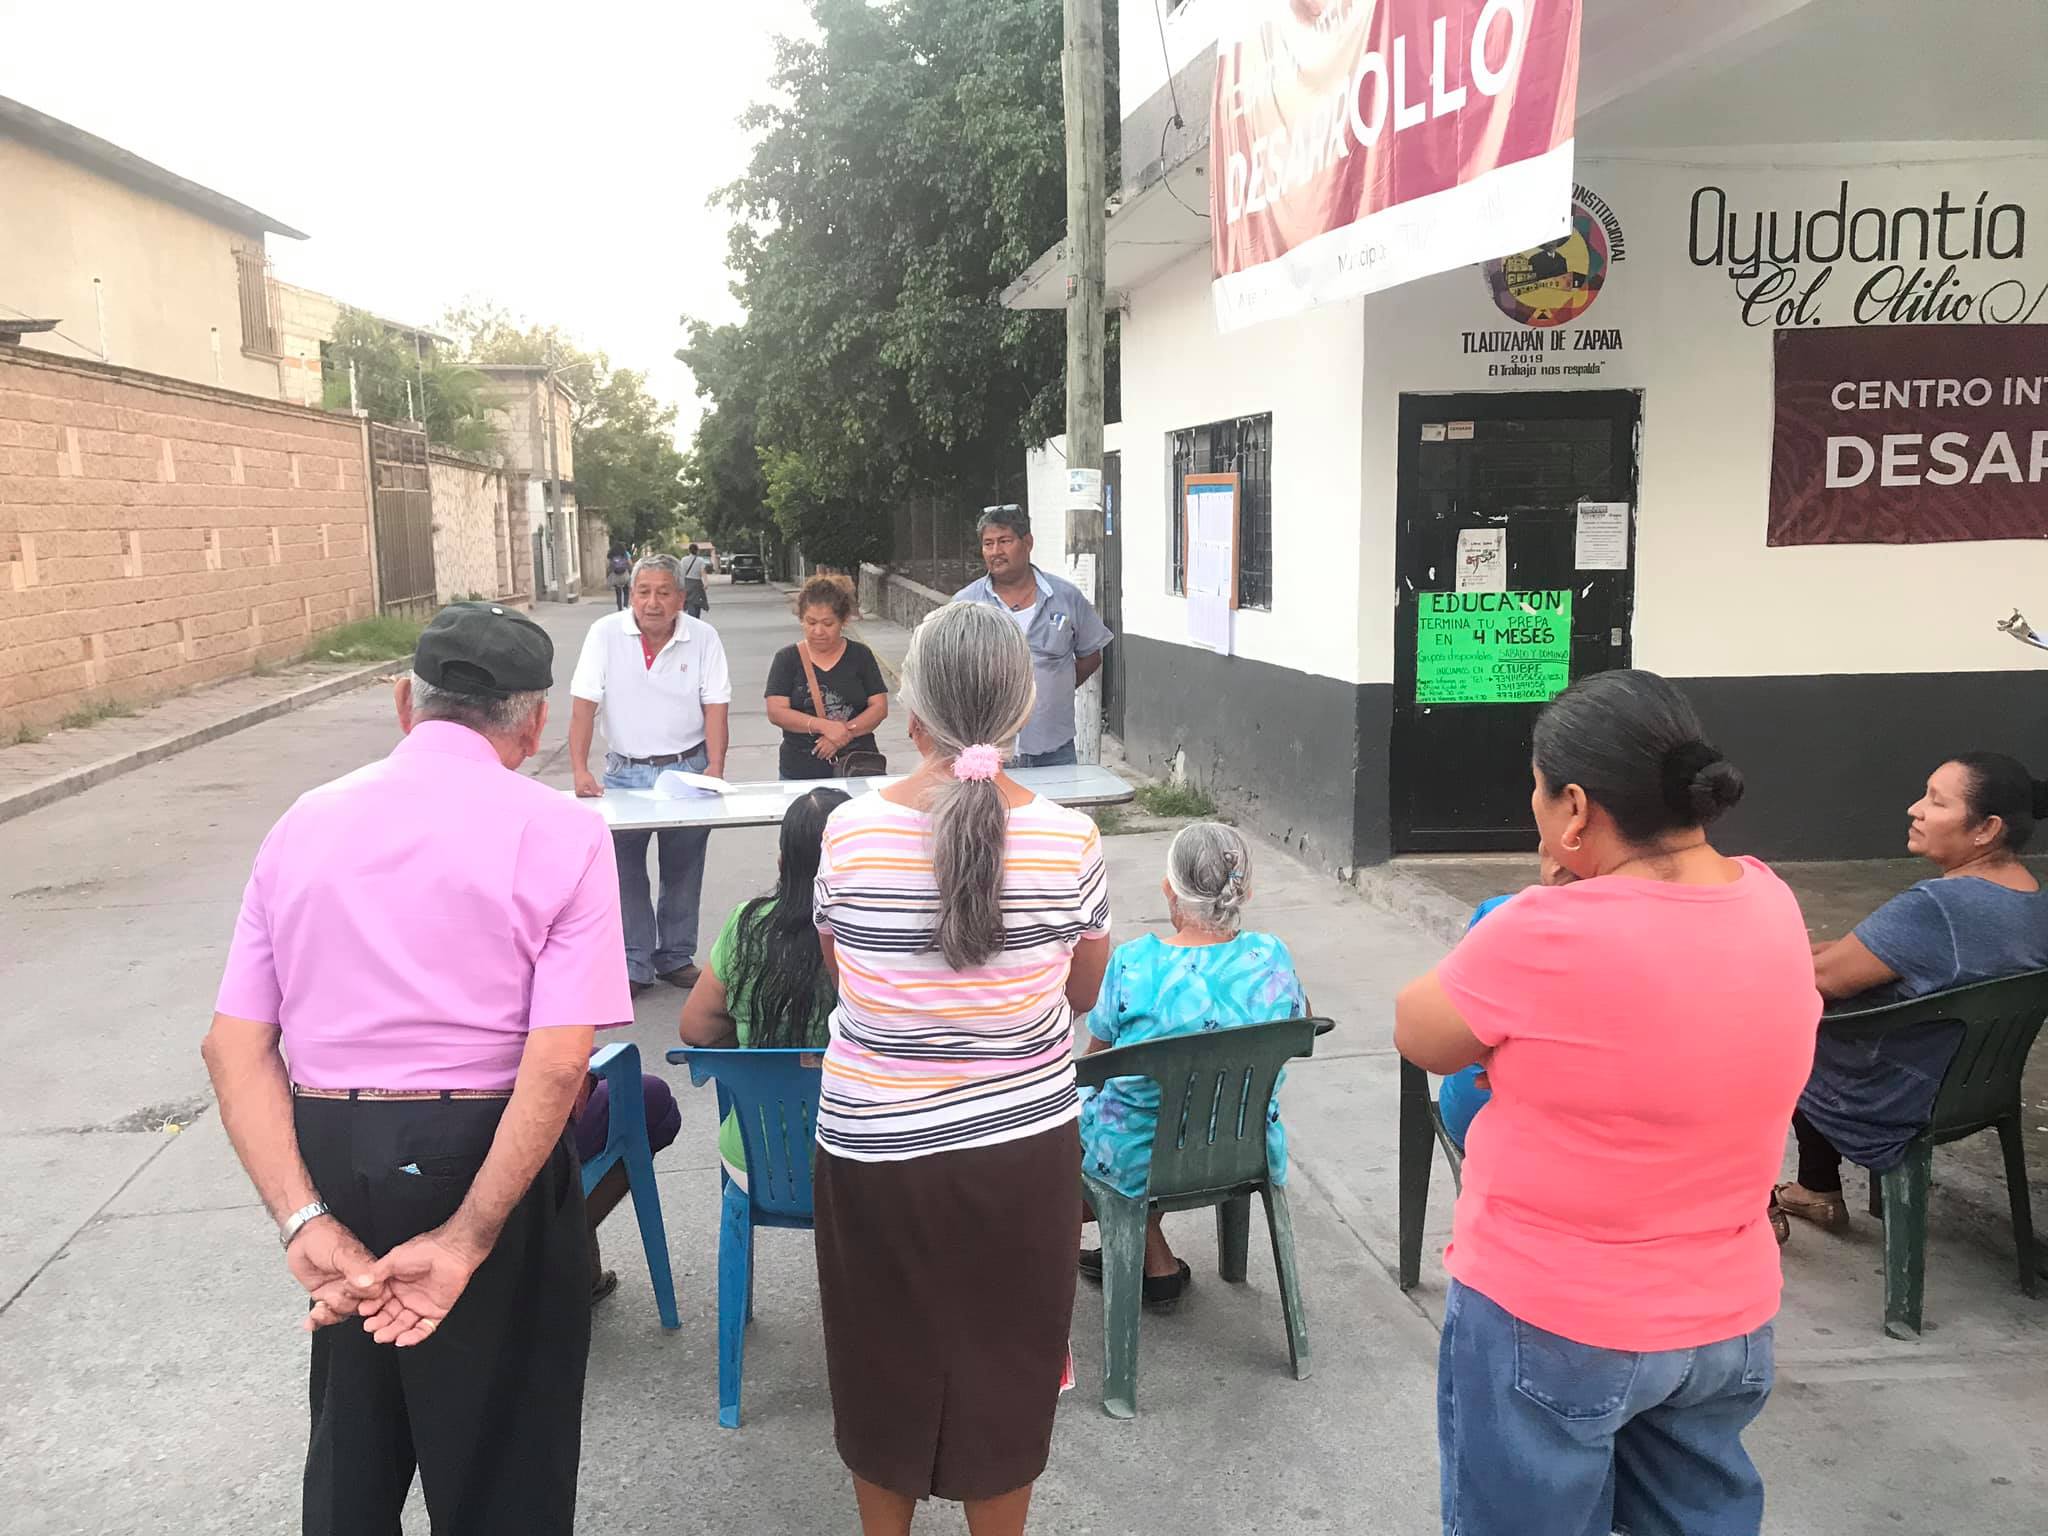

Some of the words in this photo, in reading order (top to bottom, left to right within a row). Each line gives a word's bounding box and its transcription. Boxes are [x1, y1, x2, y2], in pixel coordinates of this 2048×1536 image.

[1736, 261, 1832, 327] Col.
[1853, 264, 1979, 325] Otilio
[1551, 330, 1566, 350] DE
[1574, 329, 1623, 350] ZAPATA
[1511, 354, 1543, 363] 2019
[1489, 364, 1498, 376] El
[1501, 364, 1537, 377] Trabajo
[1541, 366, 1561, 375] nos
[1831, 377, 1993, 411] CENTRO
[1420, 617, 1470, 629] TERMINA
[1478, 618, 1495, 629] TU
[1508, 616, 1549, 628] PREPA
[1436, 634, 1453, 645] EN
[1473, 629, 1485, 644] 4
[1496, 628, 1555, 644] MESES
[1492, 663, 1543, 674] OCTUBRE
